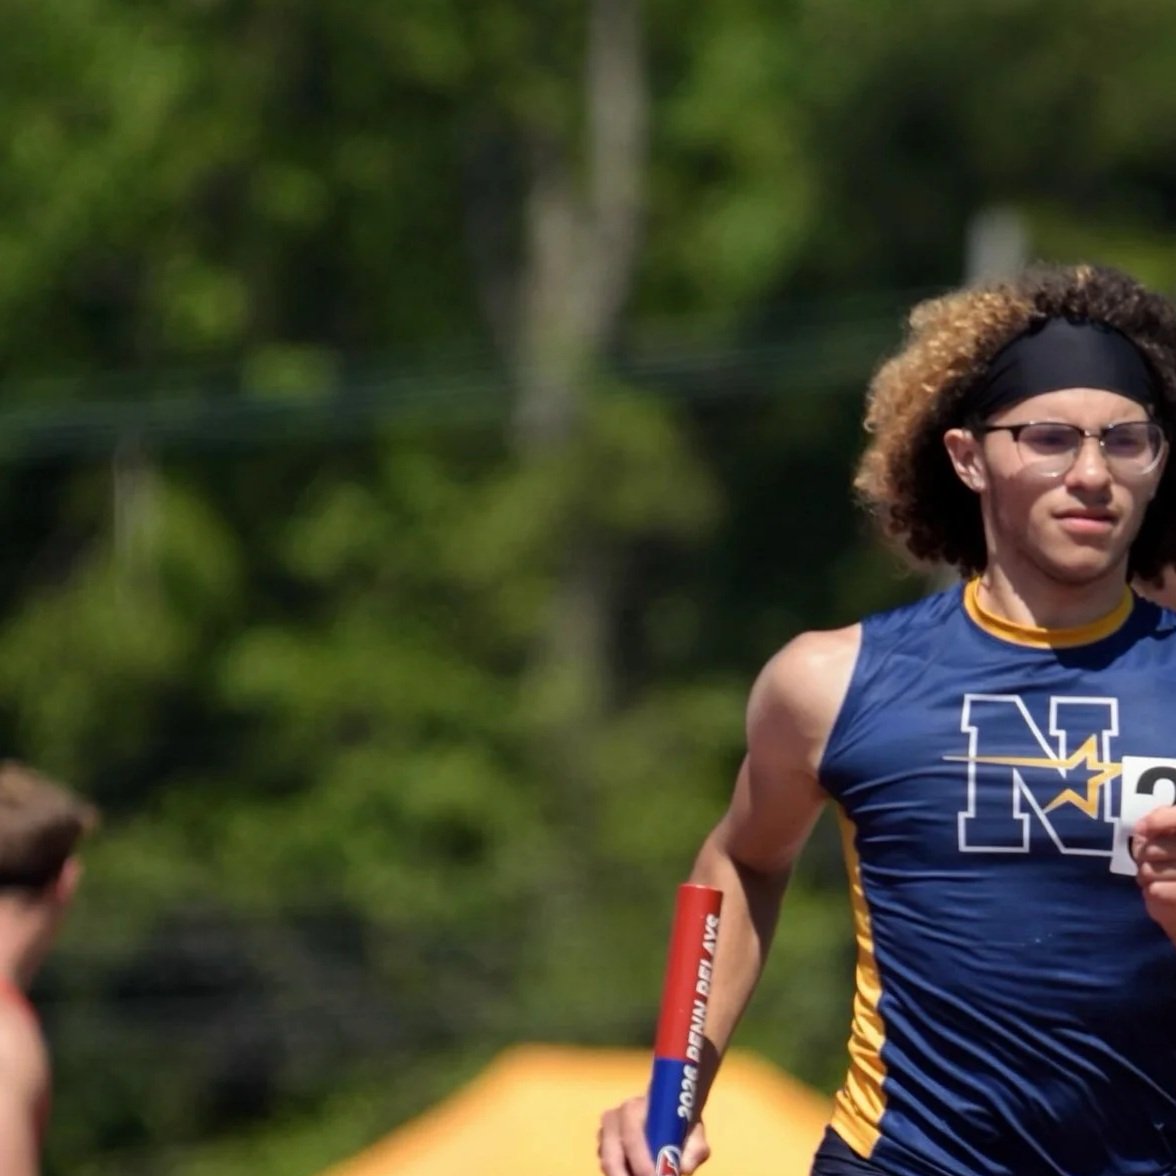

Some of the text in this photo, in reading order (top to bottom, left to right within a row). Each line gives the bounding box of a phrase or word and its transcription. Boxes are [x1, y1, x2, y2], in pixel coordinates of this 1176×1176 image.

[958, 693, 1119, 857] N
[686, 999, 706, 1064] PENN
[696, 913, 719, 997] RELAYS
